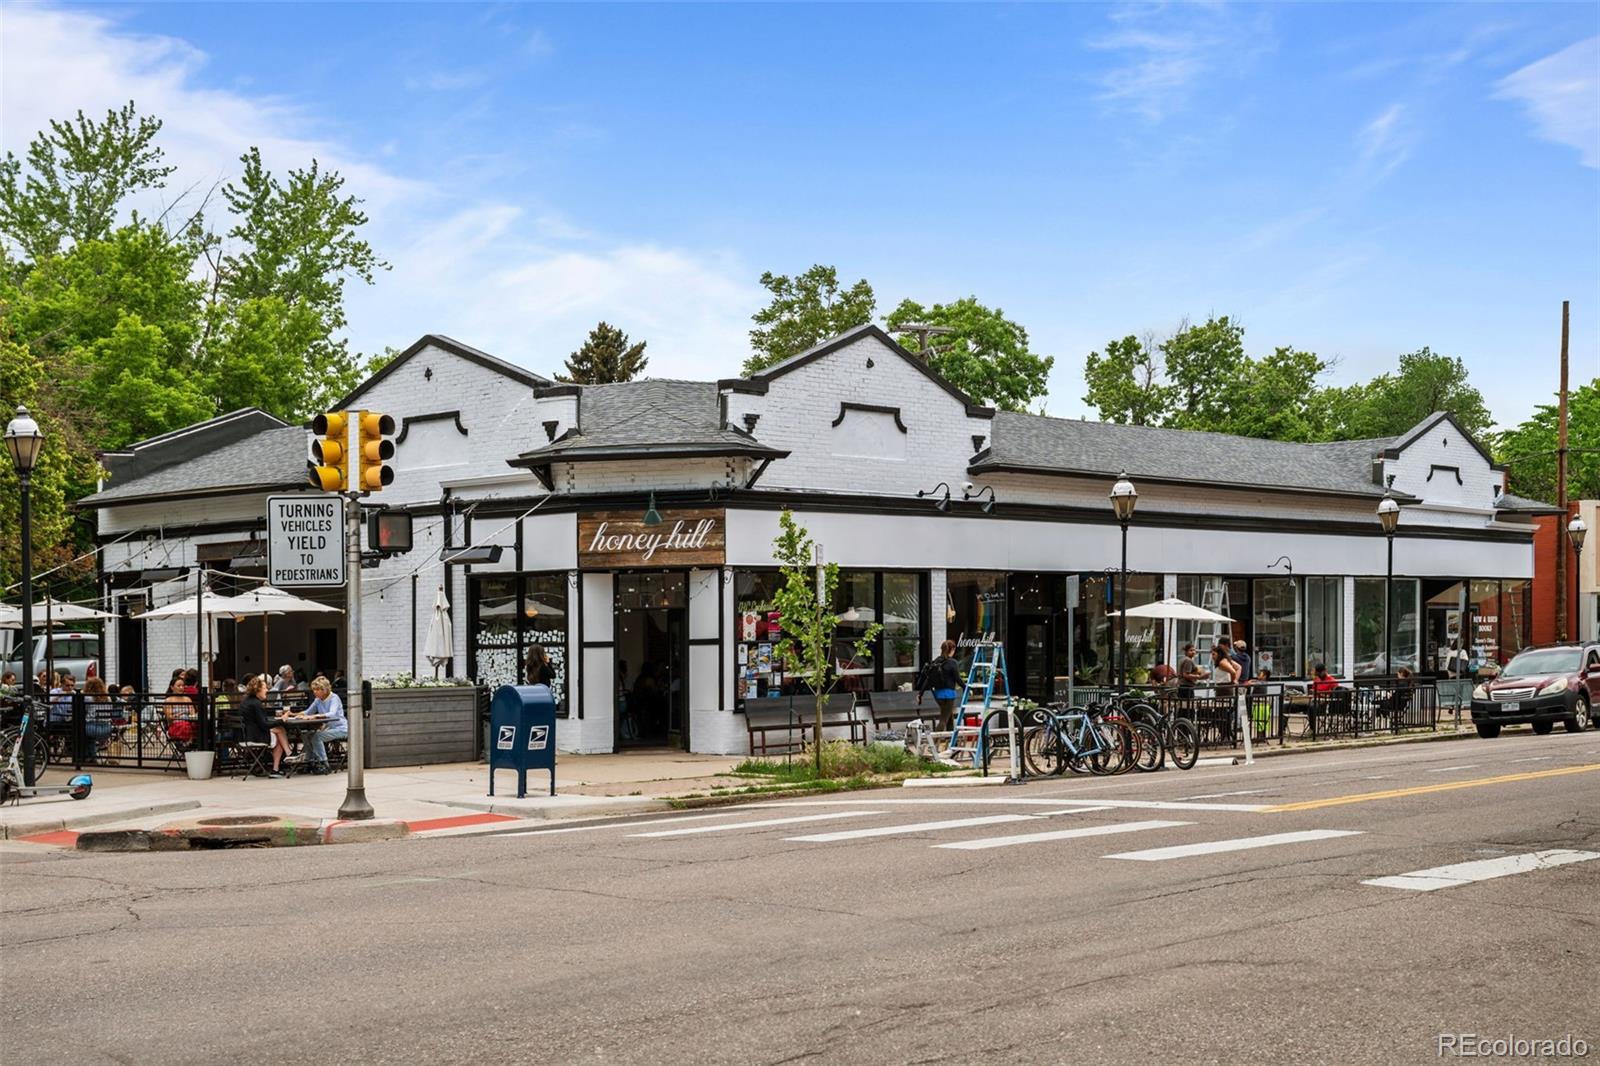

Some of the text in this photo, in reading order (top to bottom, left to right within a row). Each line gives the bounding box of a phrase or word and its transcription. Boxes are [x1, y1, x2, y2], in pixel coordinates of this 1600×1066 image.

[278, 503, 334, 518] TURNING
[281, 520, 332, 532] VEHICLES
[287, 535, 327, 550] YIELD
[589, 518, 716, 561] honey hill
[300, 553, 314, 566] TO
[275, 568, 339, 581] PEDESTRIANS
